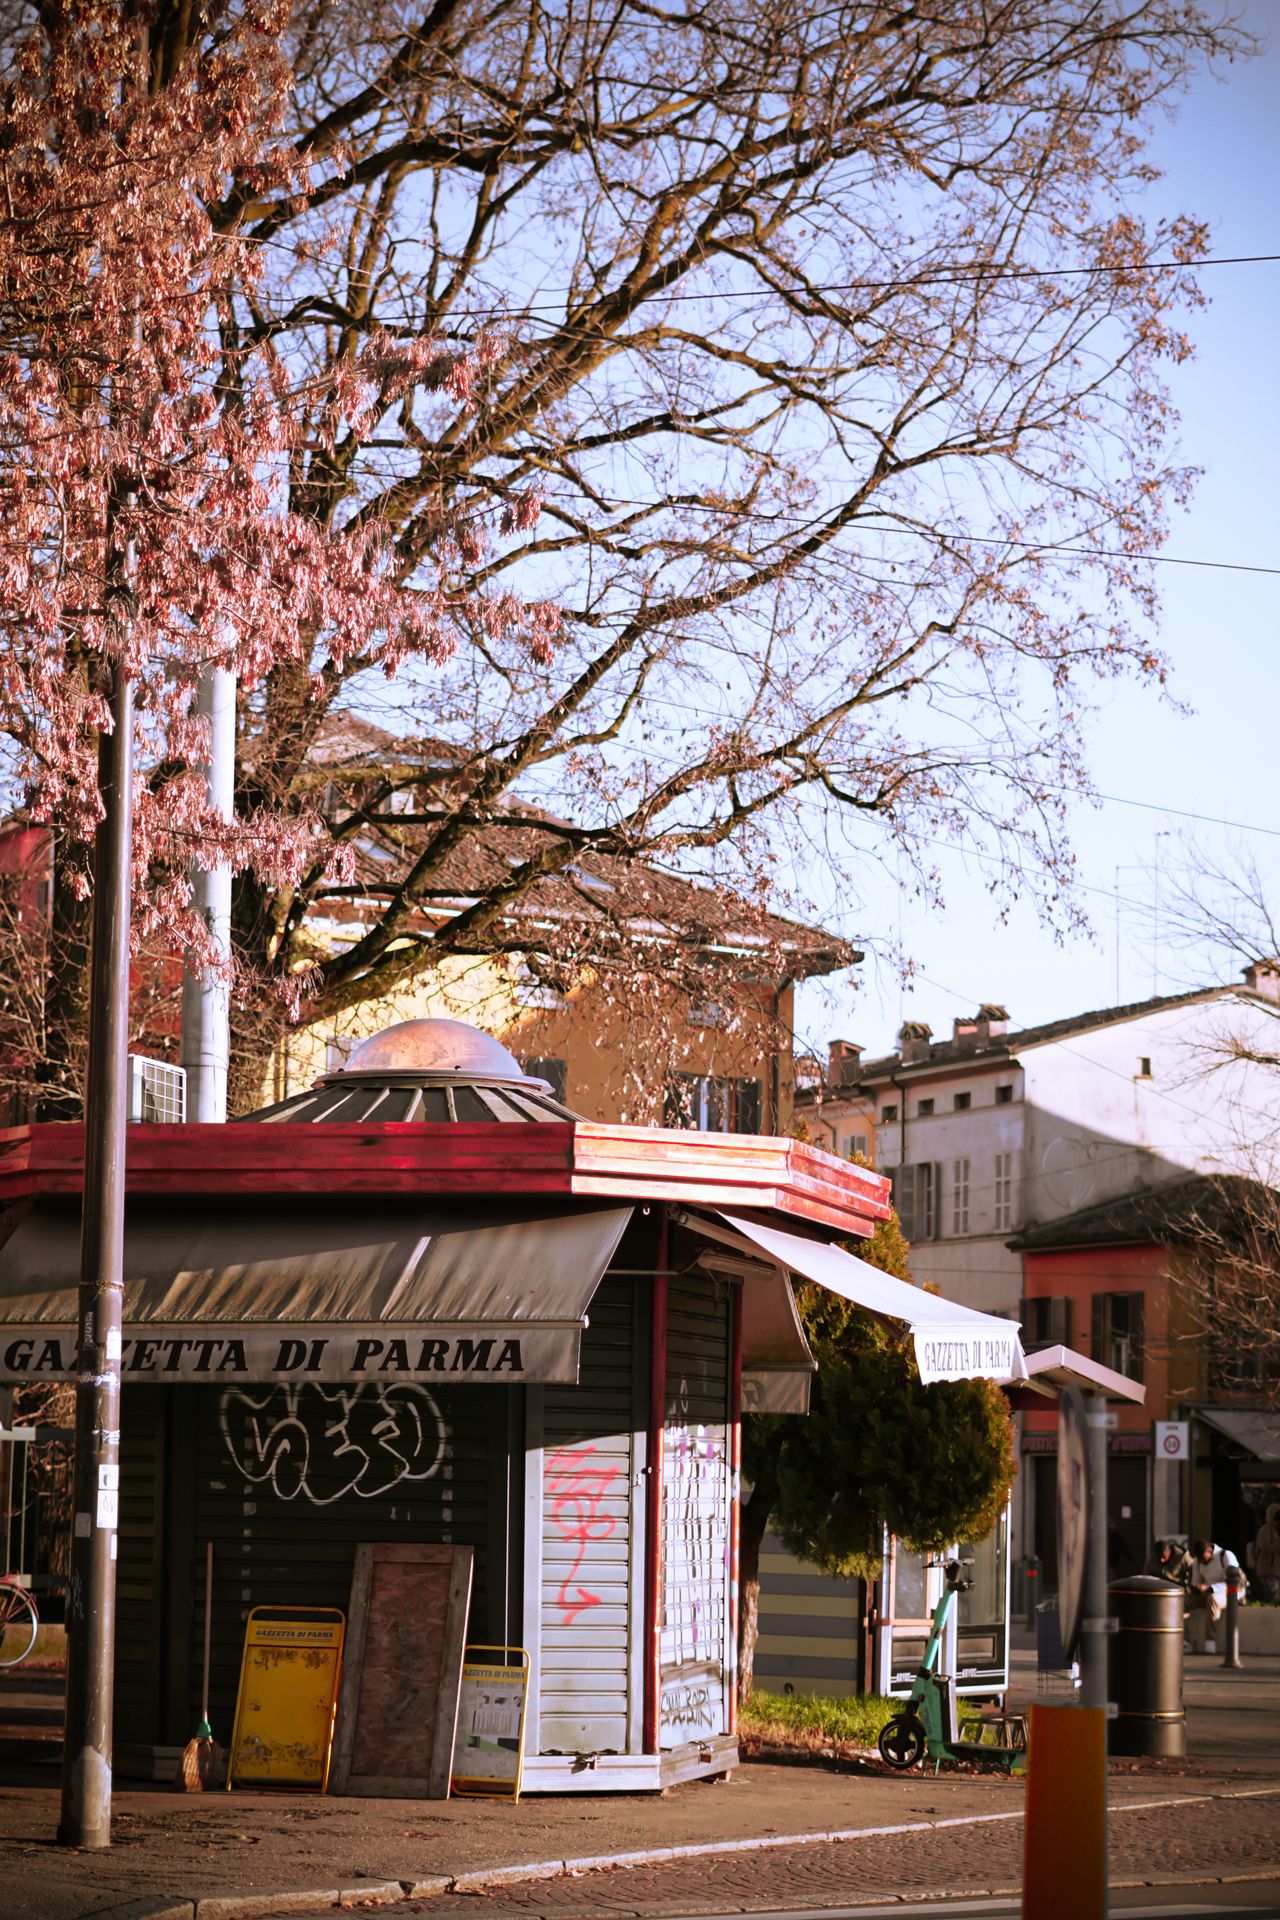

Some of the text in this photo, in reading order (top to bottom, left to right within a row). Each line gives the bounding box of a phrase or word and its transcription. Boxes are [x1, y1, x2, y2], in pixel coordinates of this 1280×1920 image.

[4, 1339, 524, 1372] GAETTA DI PARMA
[924, 1340, 1011, 1372] GAZZETTA DI PARMA
